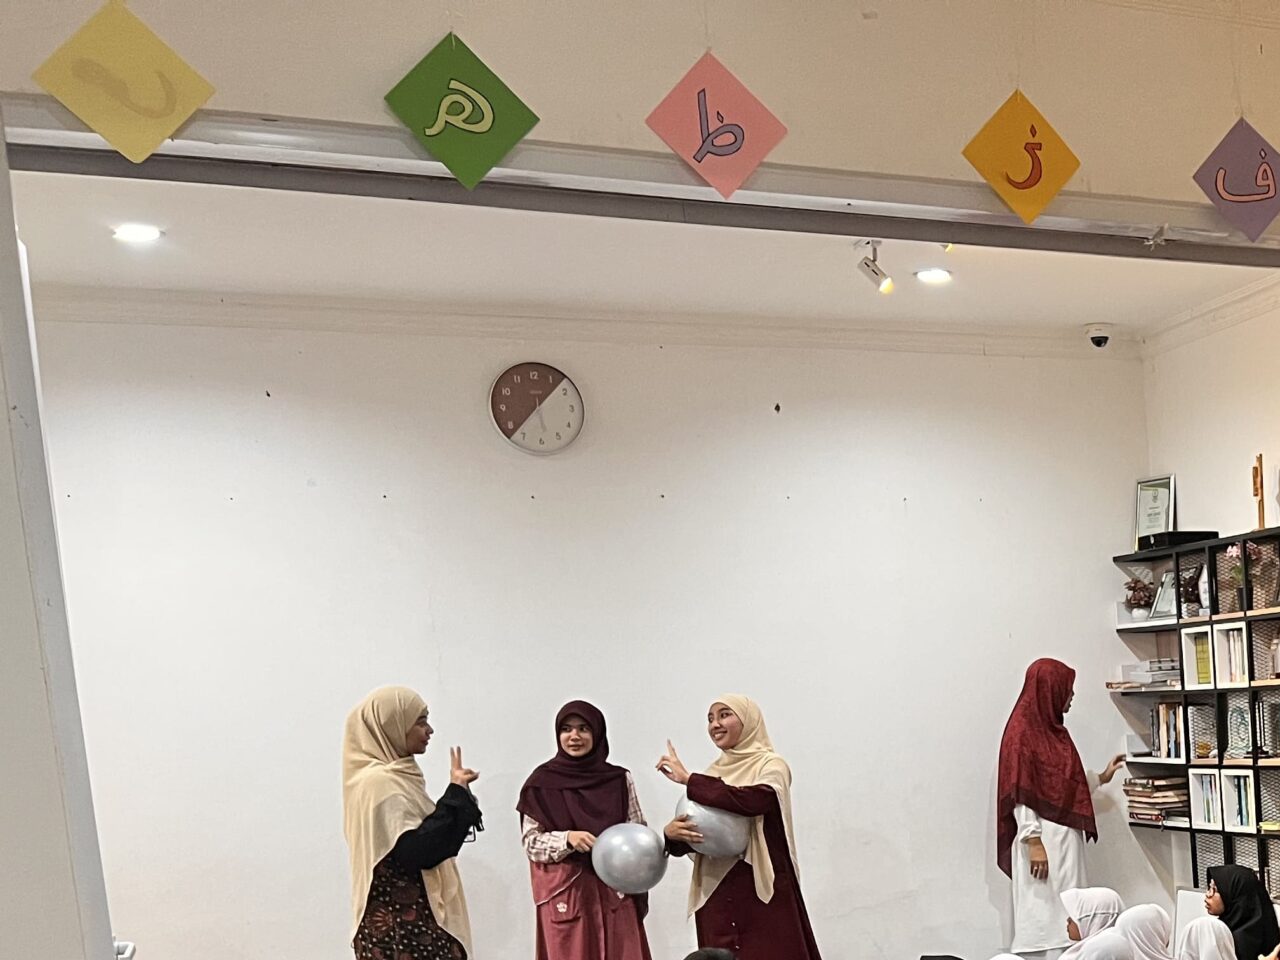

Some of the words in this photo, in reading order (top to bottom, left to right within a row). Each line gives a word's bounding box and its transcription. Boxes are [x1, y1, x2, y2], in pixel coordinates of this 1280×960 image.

[693, 88, 744, 163] ظ
[1006, 124, 1043, 190] ز
[1215, 148, 1277, 203] ف
[514, 375, 520, 383] 11
[530, 371, 539, 380] 12
[502, 387, 511, 396] 10
[562, 388, 567, 396] 2
[500, 404, 506, 412] 9
[569, 404, 575, 413] 3
[520, 432, 526, 440] 7
[556, 432, 561, 440] 5
[539, 437, 545, 445] 6
